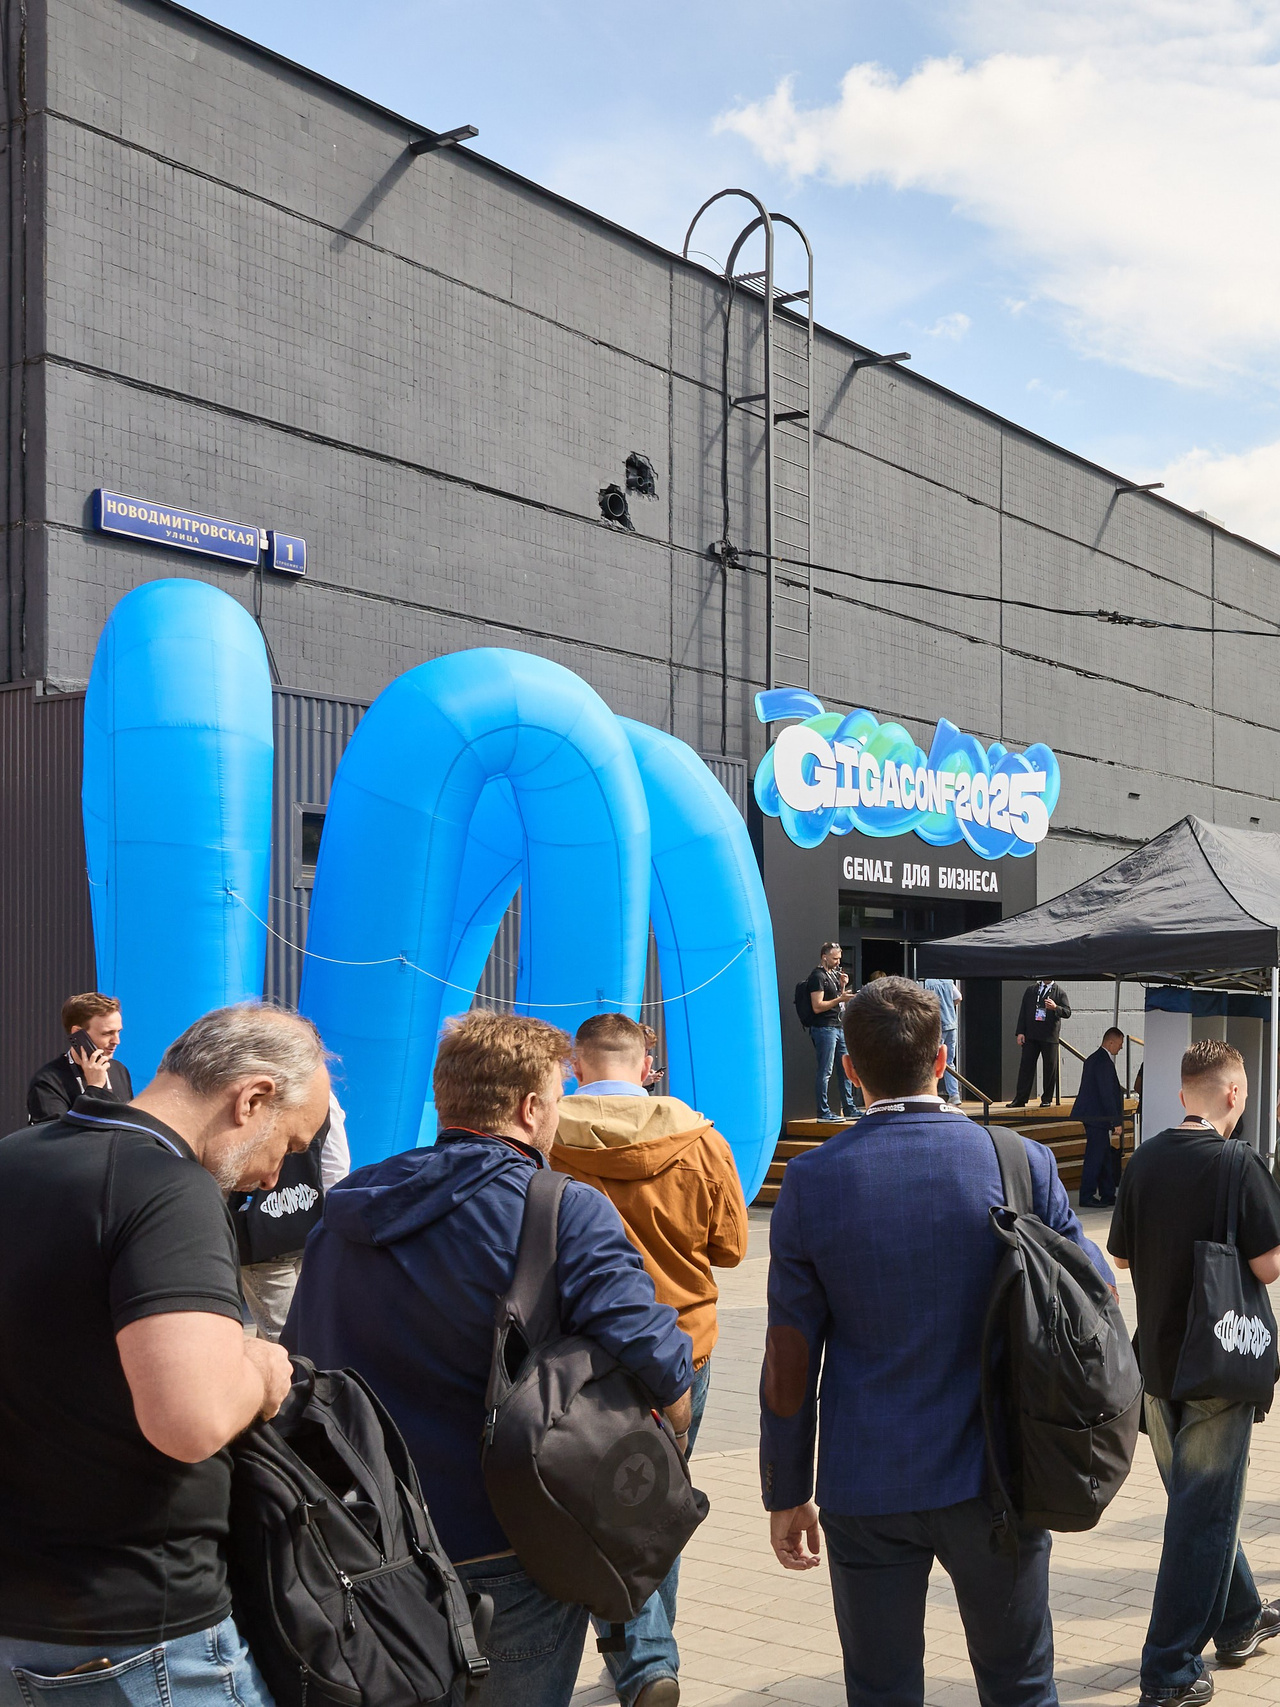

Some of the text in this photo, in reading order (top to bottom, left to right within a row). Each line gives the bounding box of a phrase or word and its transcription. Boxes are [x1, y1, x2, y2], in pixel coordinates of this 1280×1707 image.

[106, 500, 254, 547] НОВОДМИТРОВСКАЯ
[165, 530, 199, 544] УЛИЦА
[285, 543, 294, 561] 1
[773, 724, 1050, 843] GIGACONF2025
[843, 856, 998, 893] GENAI ДЛЯ БИЗНЕСА
